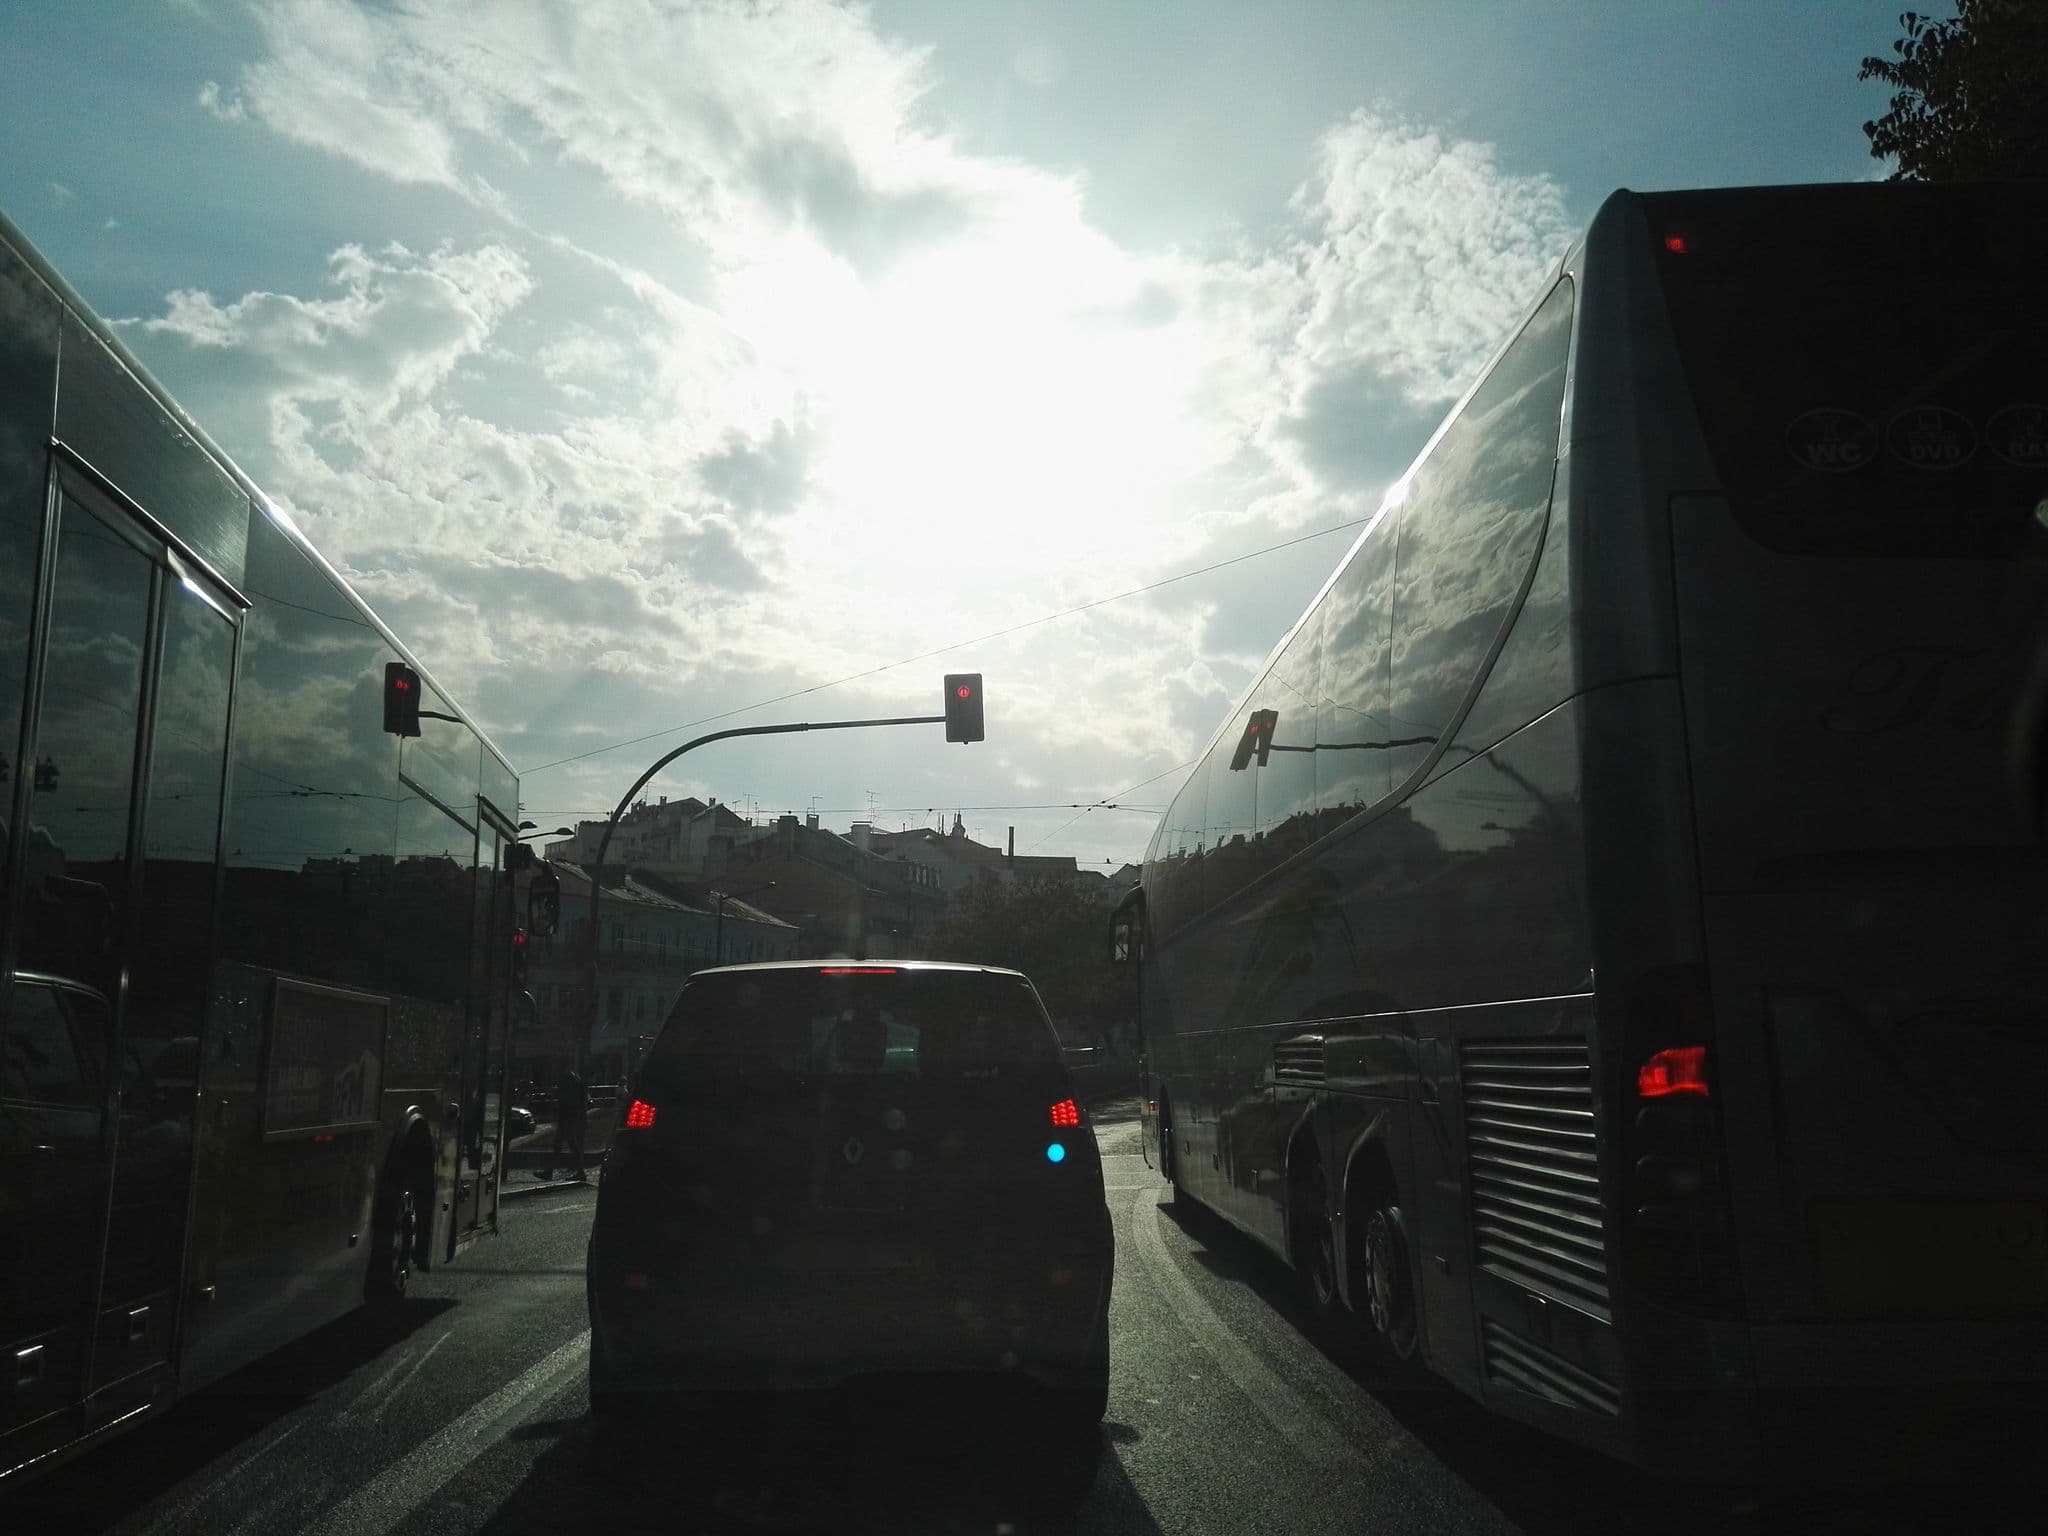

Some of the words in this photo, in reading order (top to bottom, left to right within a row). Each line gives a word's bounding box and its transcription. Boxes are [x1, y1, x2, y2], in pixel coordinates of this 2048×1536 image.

[1807, 442, 1862, 464] WC
[1910, 444, 1961, 460] DVD
[2008, 442, 2048, 457] BA
